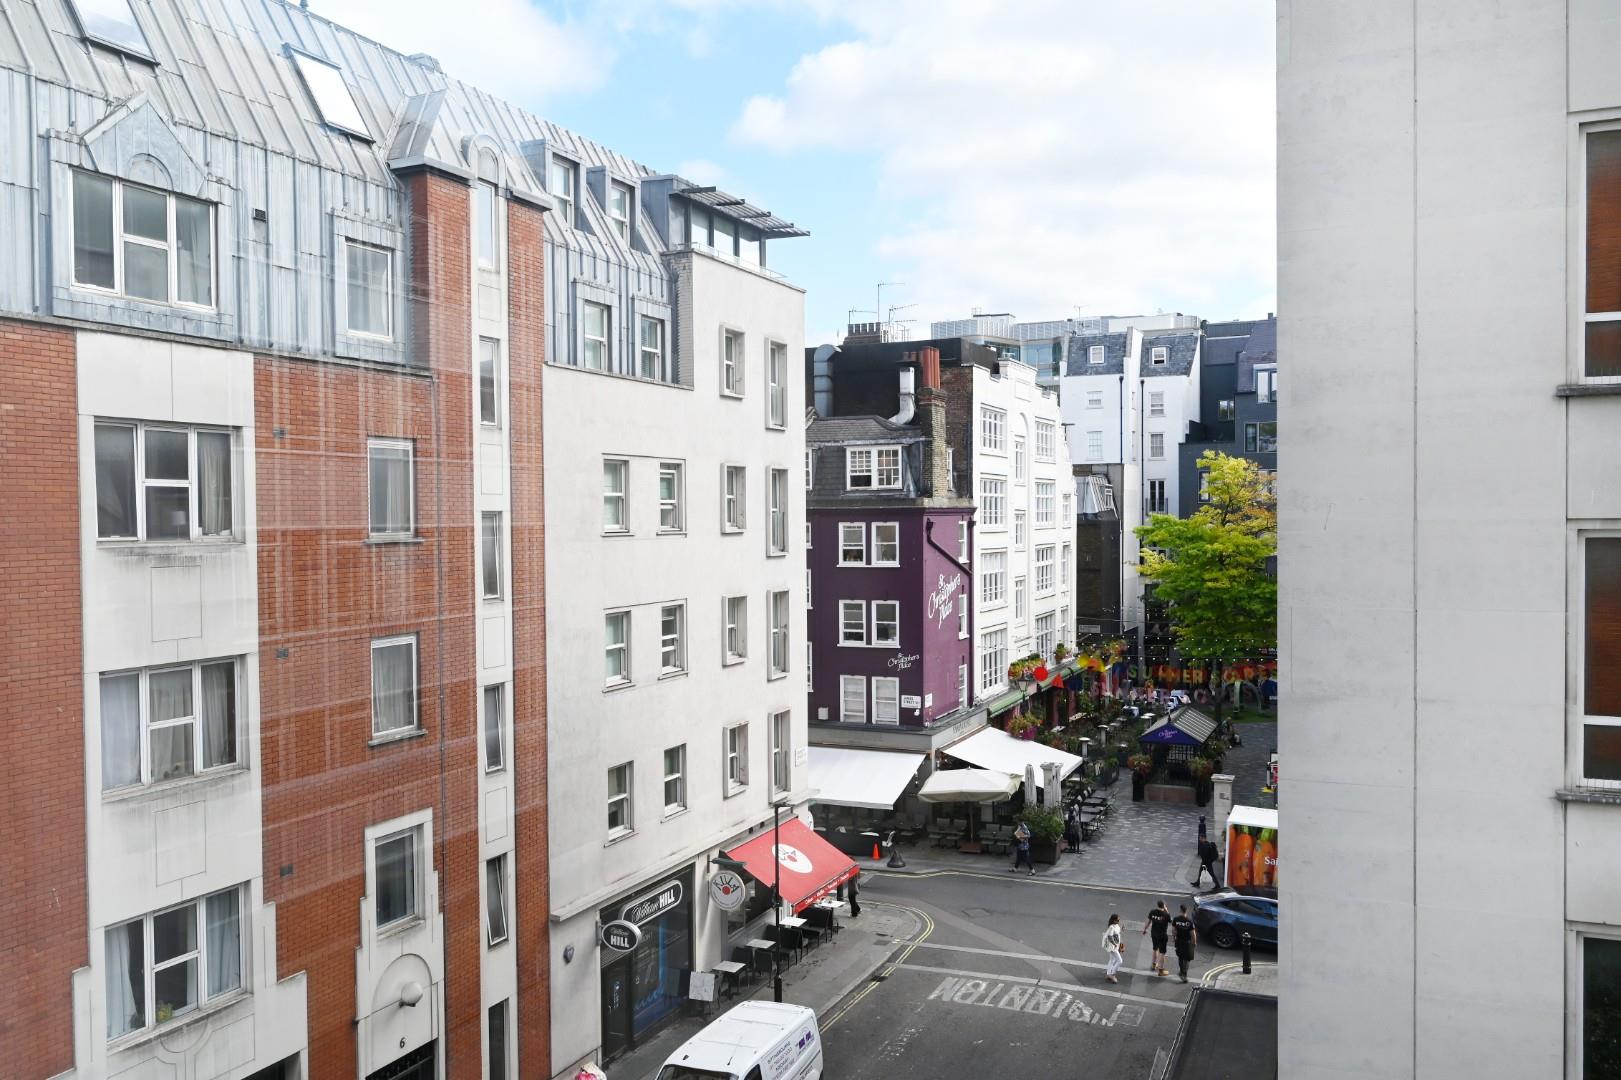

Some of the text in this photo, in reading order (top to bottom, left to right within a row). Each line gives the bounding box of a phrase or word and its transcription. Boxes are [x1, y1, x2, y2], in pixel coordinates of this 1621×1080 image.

[938, 600, 953, 629] Place
[659, 888, 676, 909] HILL
[610, 935, 630, 948] HILL
[399, 1036, 406, 1049] 6
